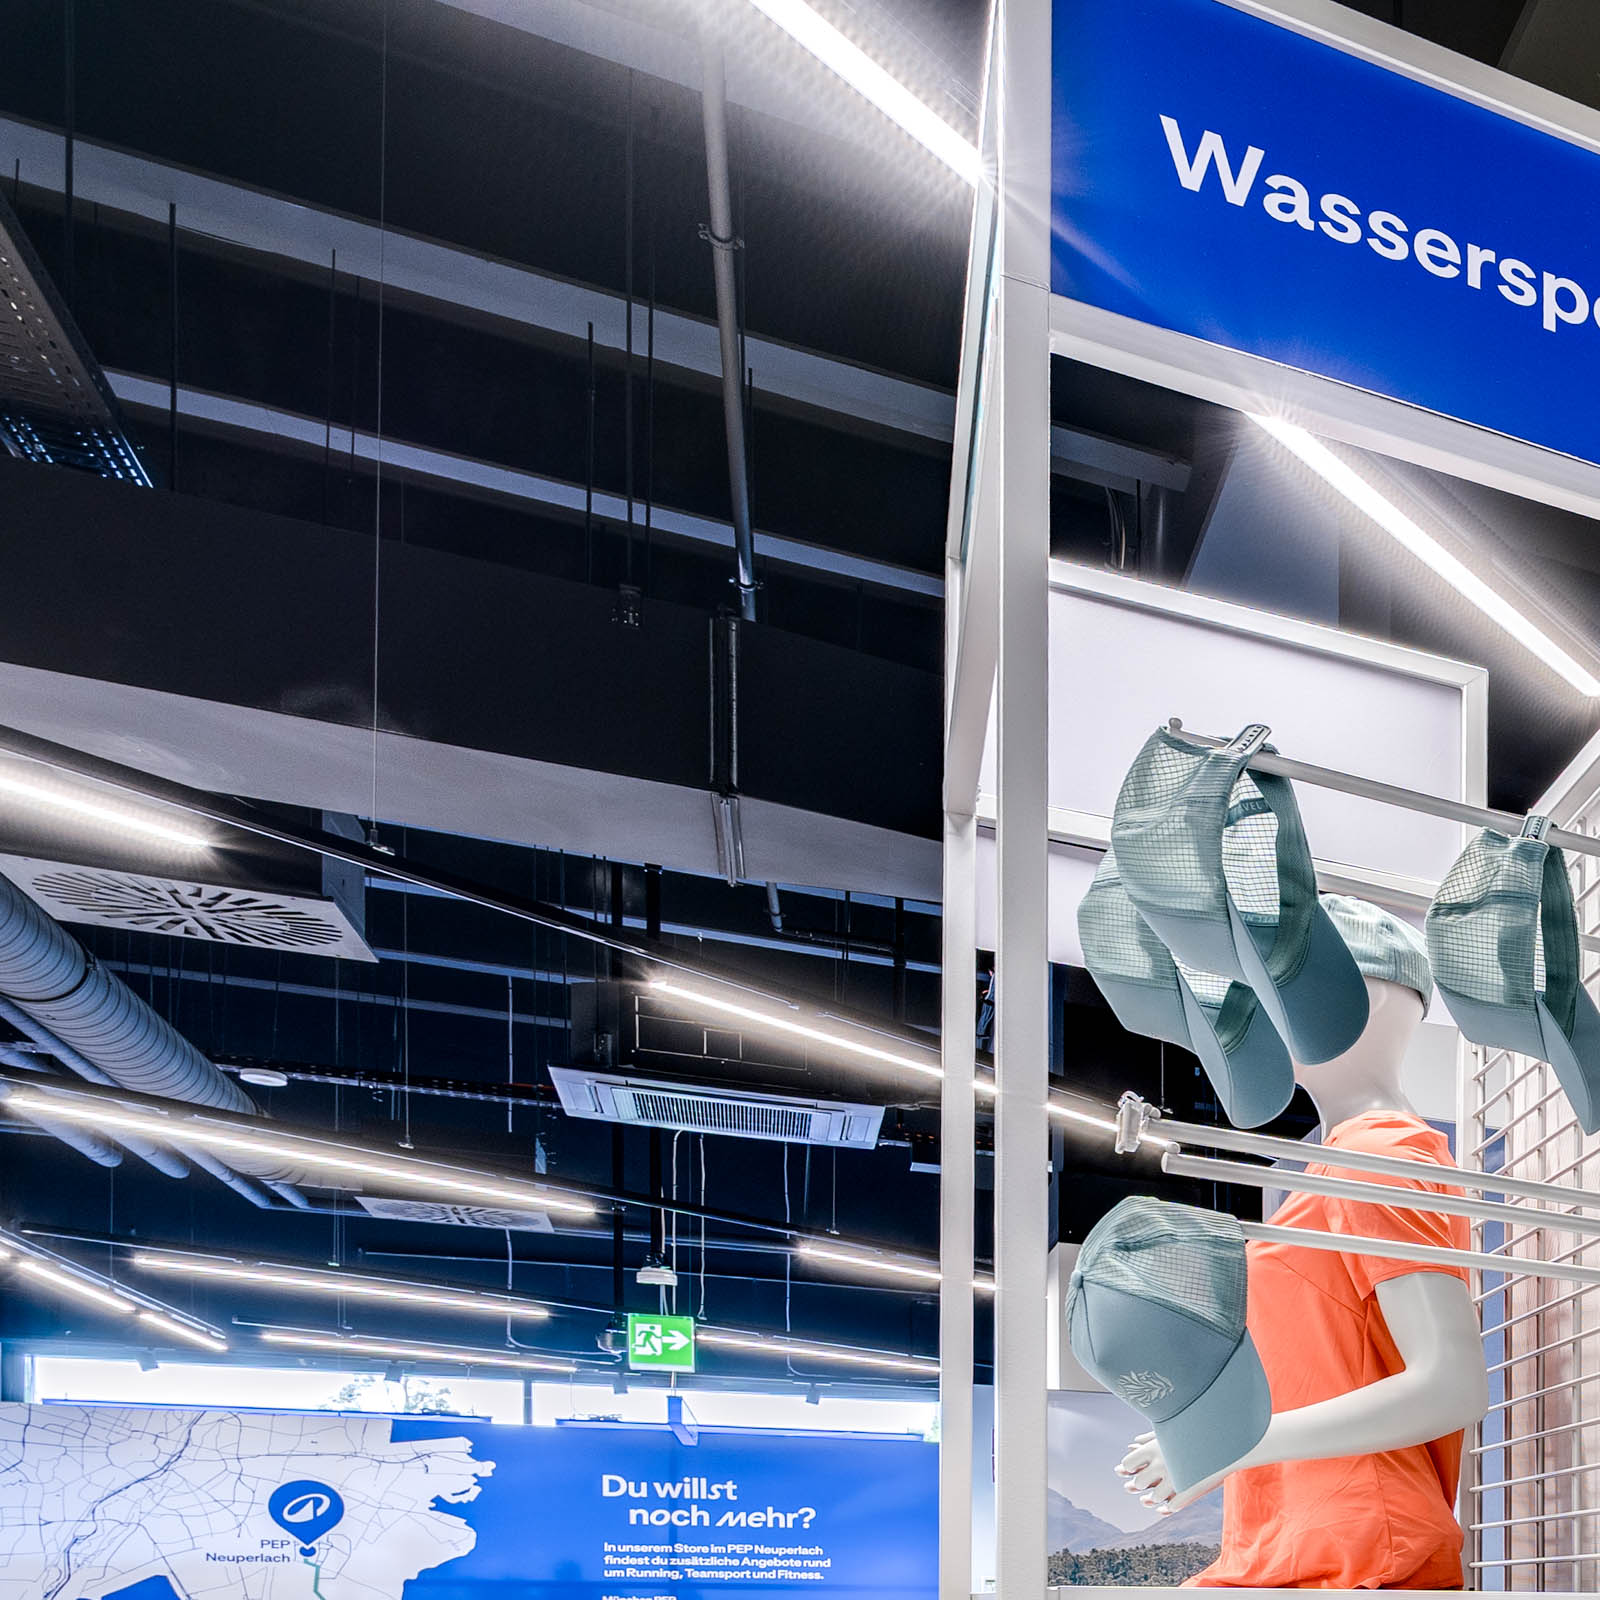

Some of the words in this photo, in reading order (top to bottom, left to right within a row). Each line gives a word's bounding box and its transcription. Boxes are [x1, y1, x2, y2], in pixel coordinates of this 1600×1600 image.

[602, 1474, 647, 1498] Du
[653, 1477, 737, 1500] willst
[629, 1504, 709, 1527] noch
[716, 1507, 816, 1529] mehr?
[260, 1540, 290, 1548] PEP
[604, 1542, 616, 1552] In
[617, 1544, 672, 1553] unserem
[674, 1543, 709, 1554] Store
[711, 1544, 726, 1553] im
[728, 1544, 753, 1554] PEP
[754, 1545, 823, 1557] Neuperlach
[205, 1553, 290, 1563] Neuperlach
[604, 1555, 649, 1565] findest
[652, 1556, 668, 1565] du
[670, 1556, 739, 1566] zusätzliche
[741, 1558, 801, 1568] Angebote
[803, 1558, 831, 1568] rund
[604, 1569, 625, 1578] um
[626, 1568, 683, 1580] Running,
[684, 1568, 750, 1581] Teamsport
[752, 1569, 776, 1579] und
[777, 1570, 824, 1580] Fitness.
